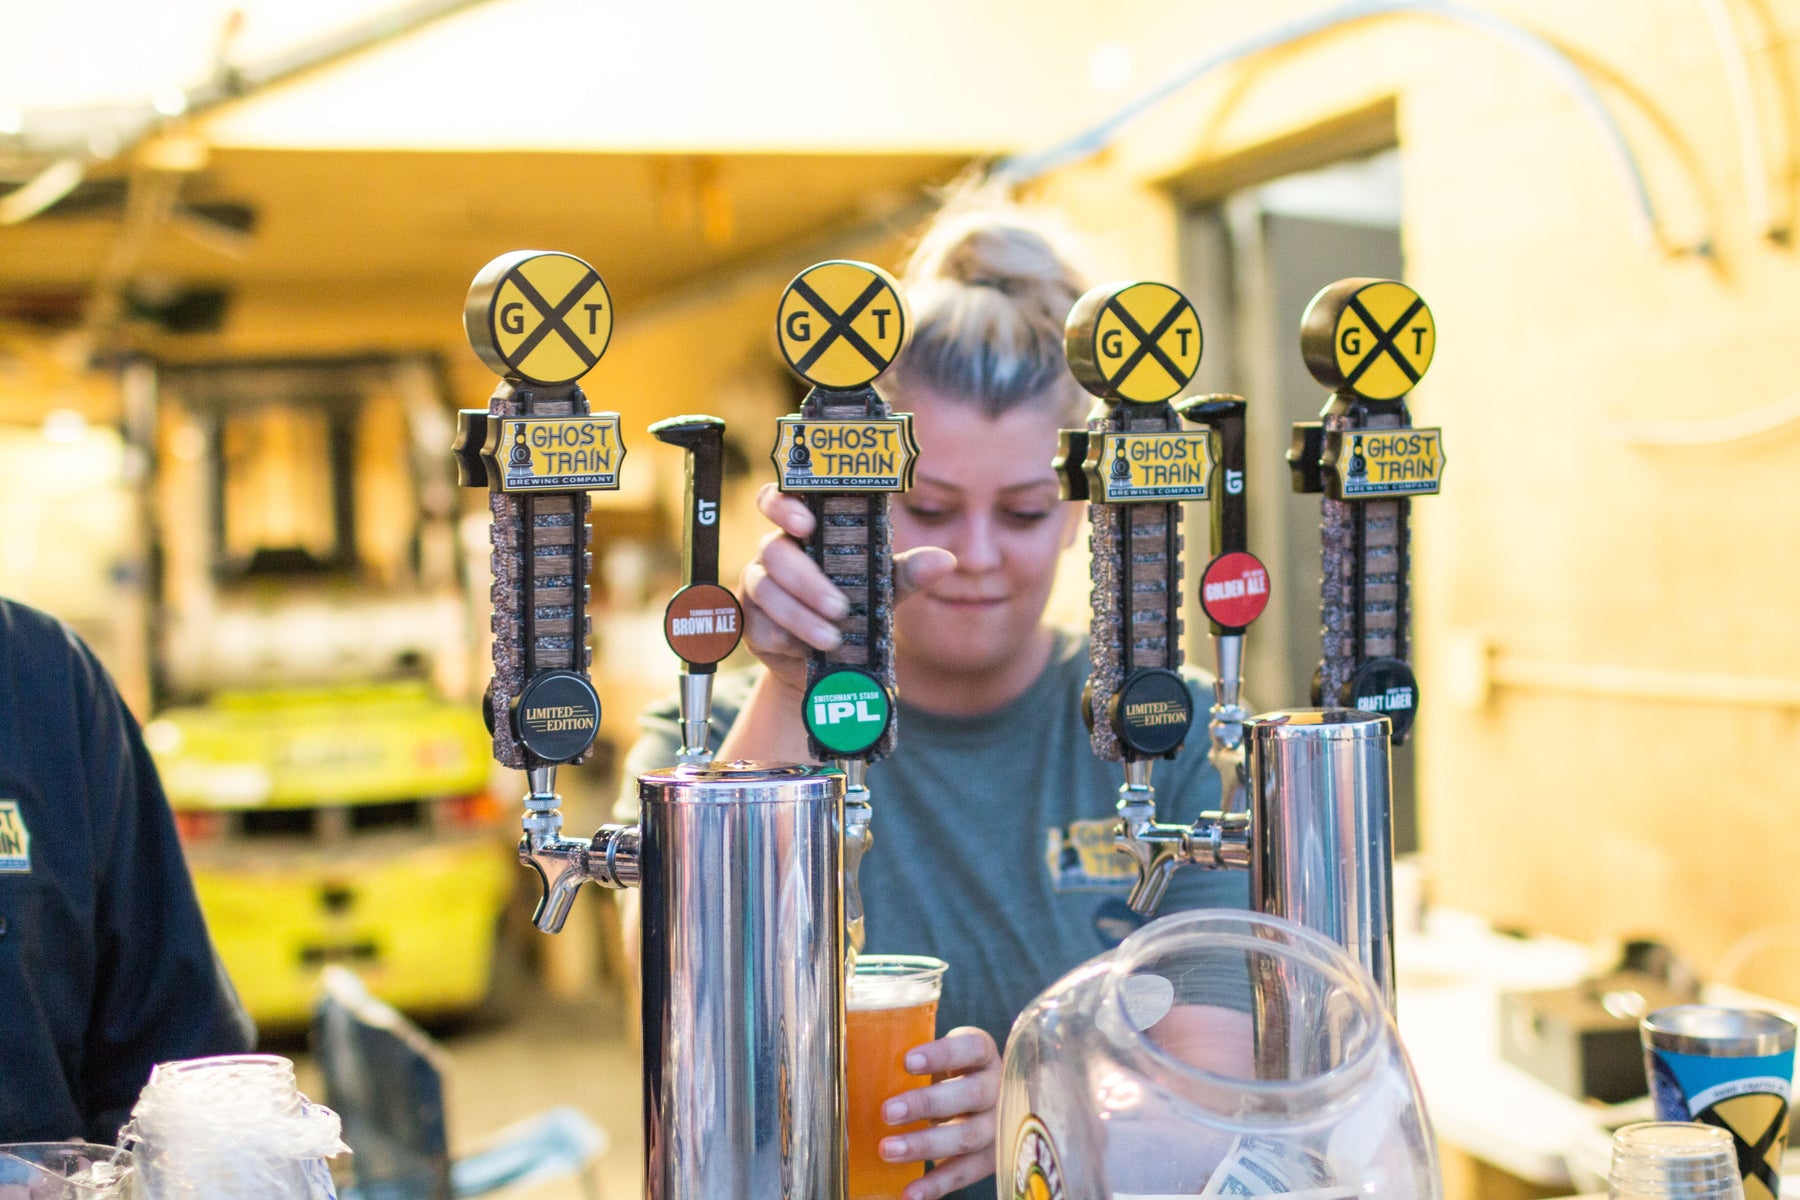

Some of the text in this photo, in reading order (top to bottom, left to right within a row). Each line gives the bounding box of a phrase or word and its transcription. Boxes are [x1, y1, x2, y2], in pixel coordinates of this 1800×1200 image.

[532, 422, 613, 449] GHOST
[811, 426, 896, 451] GHOST
[1367, 434, 1436, 458] GHOST
[541, 447, 611, 474] TRAIN
[1131, 438, 1204, 462] GHOST
[820, 451, 894, 475] TRAIN
[1138, 461, 1201, 486] TRAIN
[1375, 458, 1434, 481] TRAIN
[509, 474, 612, 486] BREWING COMPANY
[788, 478, 898, 487] BREWING COMPANY
[1111, 486, 1203, 497] BREWING COMPANY
[1226, 469, 1243, 494] GT
[698, 499, 716, 525] GT
[1206, 575, 1266, 602] GOLDEN ALE
[672, 614, 736, 636] BROWN ALE
[814, 691, 879, 703] SWITCHMAN'S STASH
[1358, 693, 1412, 711] CRAFT LAGER
[526, 706, 573, 720] LIMITED
[814, 700, 880, 725] IPL
[1126, 702, 1168, 716] LIMITED
[1144, 711, 1186, 726] EDITION
[546, 717, 594, 732] EDITION
